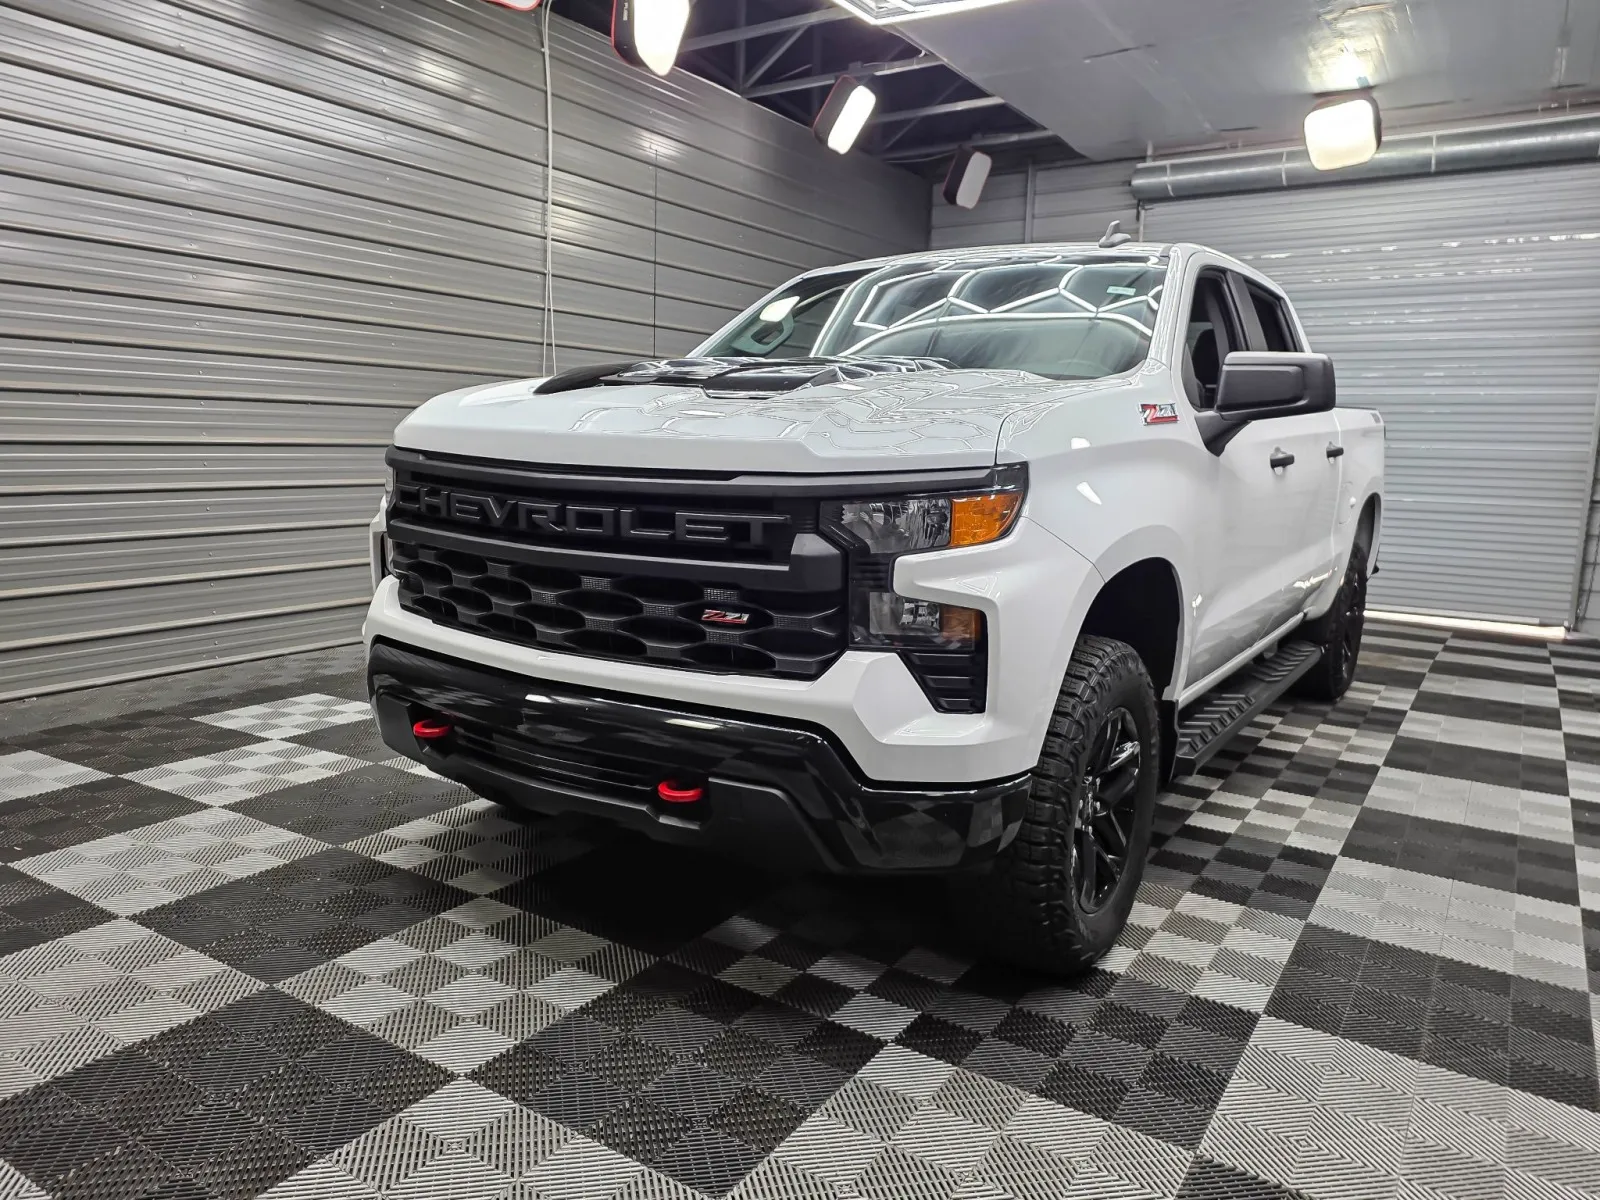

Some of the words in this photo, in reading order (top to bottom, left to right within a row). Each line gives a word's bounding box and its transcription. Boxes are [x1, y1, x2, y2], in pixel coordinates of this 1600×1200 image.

[1139, 403, 1179, 425] Z71
[396, 483, 791, 545] CHEVROLET
[701, 609, 750, 624] Z71
